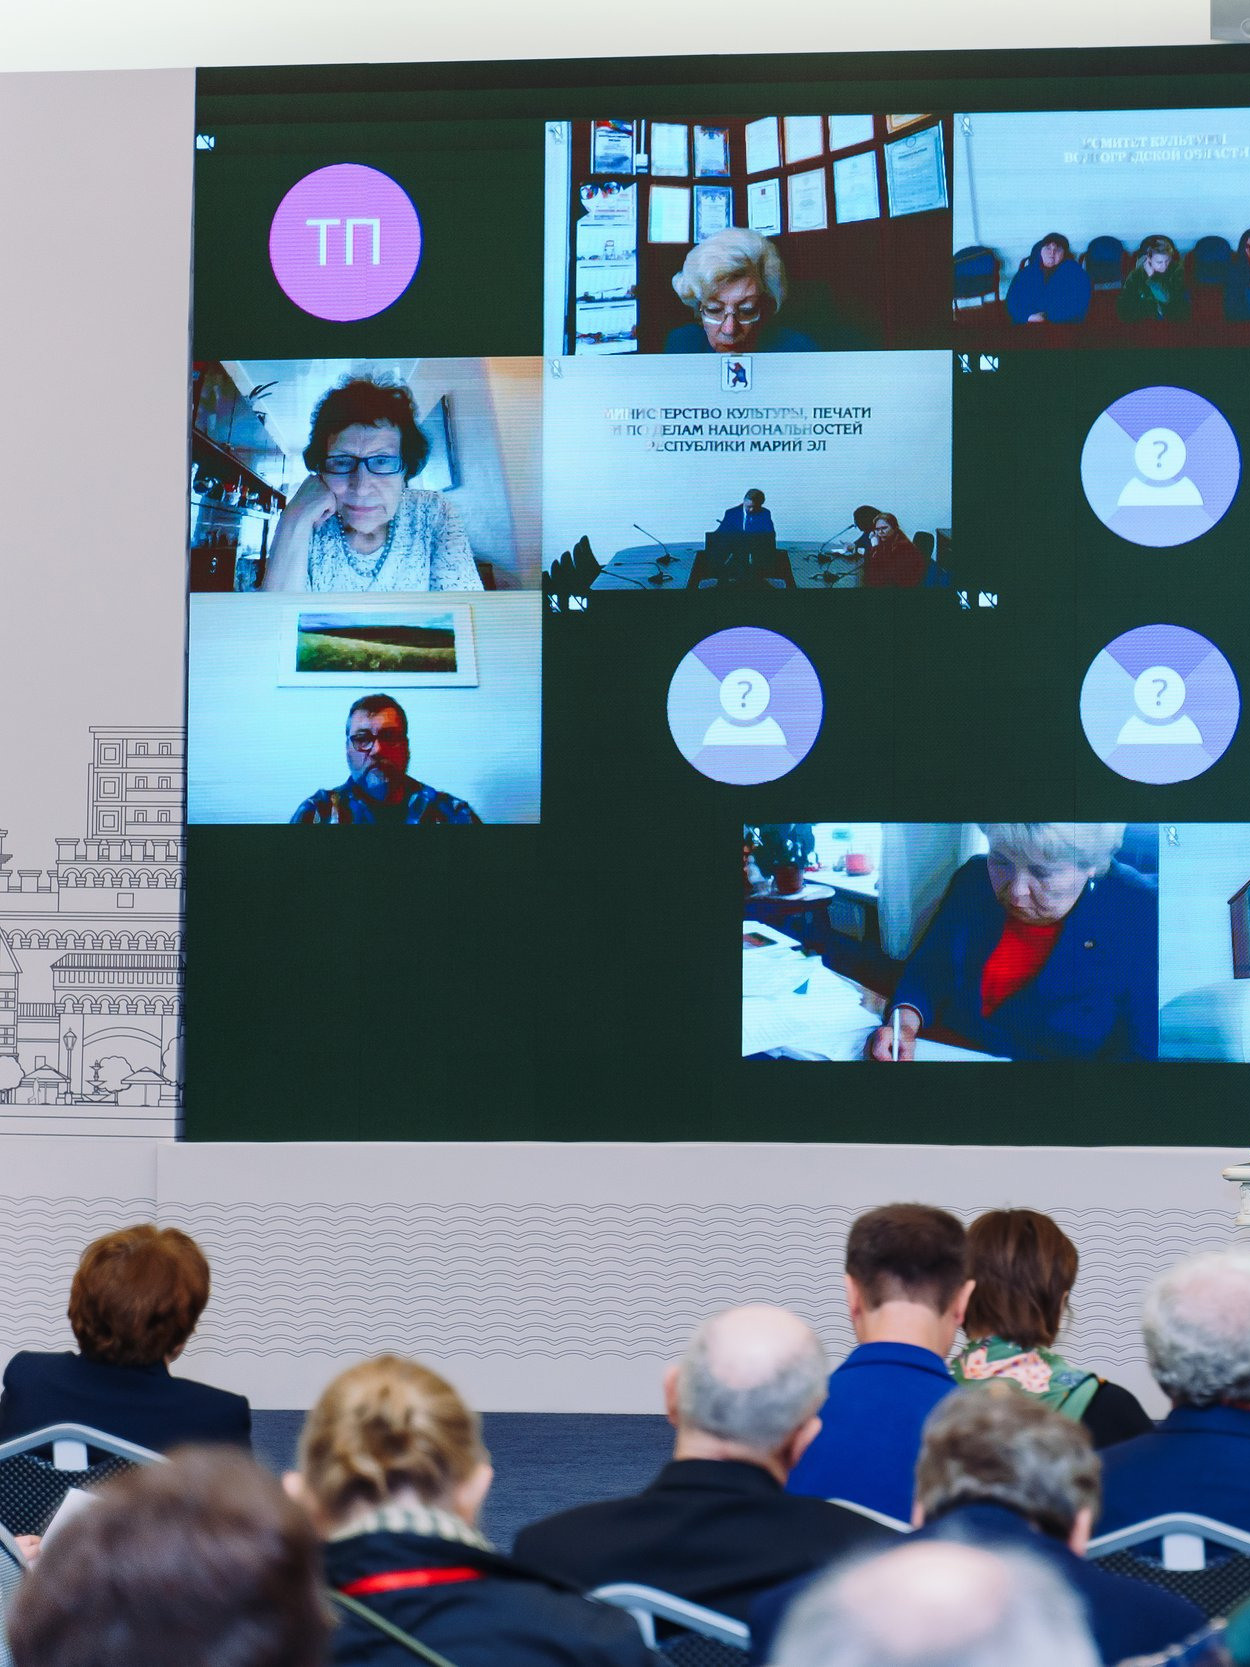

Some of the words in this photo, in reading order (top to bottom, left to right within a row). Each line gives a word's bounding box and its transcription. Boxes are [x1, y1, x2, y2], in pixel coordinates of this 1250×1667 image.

[305, 218, 381, 267] ТП
[812, 407, 872, 419] ПЕЧАТИ
[708, 421, 863, 436] НАЦИОНАЛЬНОСТЕЙ
[750, 438, 803, 452] МАРИЙ
[806, 440, 828, 452] ЭЛ
